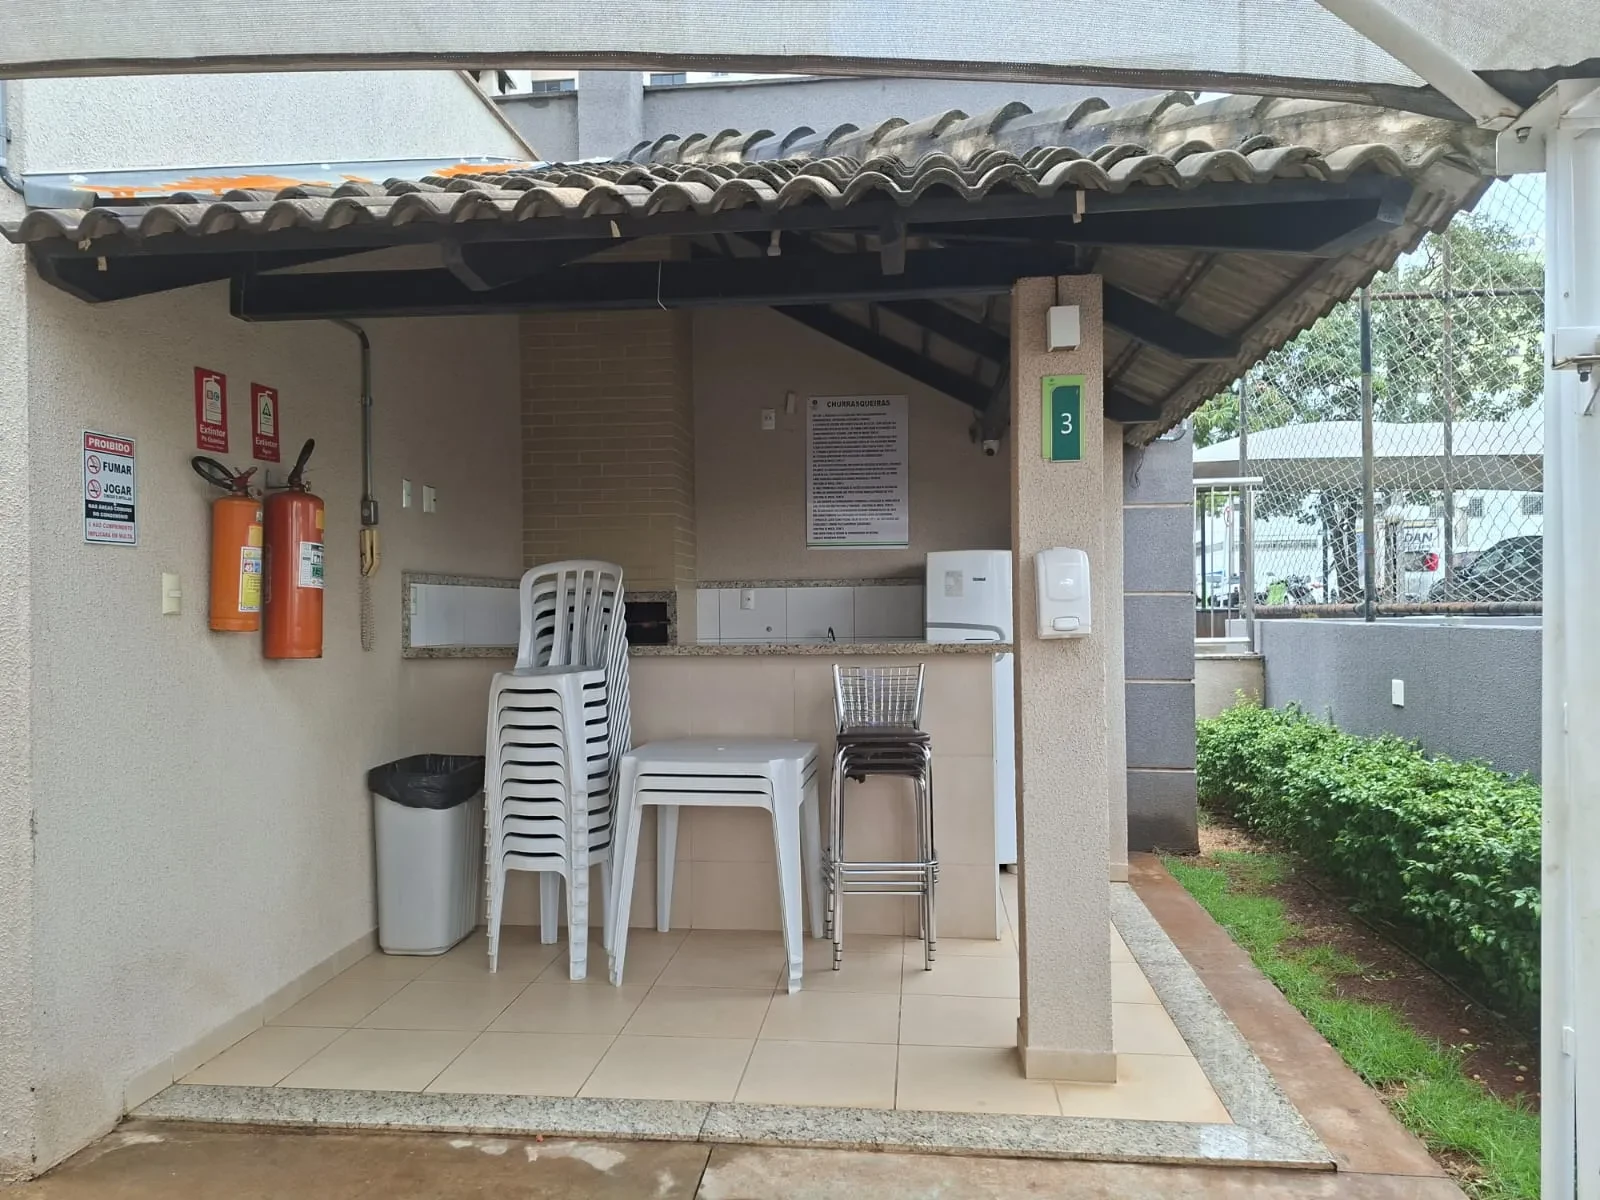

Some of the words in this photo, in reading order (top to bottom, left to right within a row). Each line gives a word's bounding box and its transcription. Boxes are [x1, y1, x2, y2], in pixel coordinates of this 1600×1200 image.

[826, 399, 891, 408] CHURRASQUEIRAS
[1060, 412, 1073, 435] 3
[200, 424, 226, 437] Extintor
[88, 437, 130, 452] PROIBIDO
[256, 436, 278, 448] Extintor
[103, 462, 132, 476] FUMAR
[104, 484, 132, 496] JOGAR
